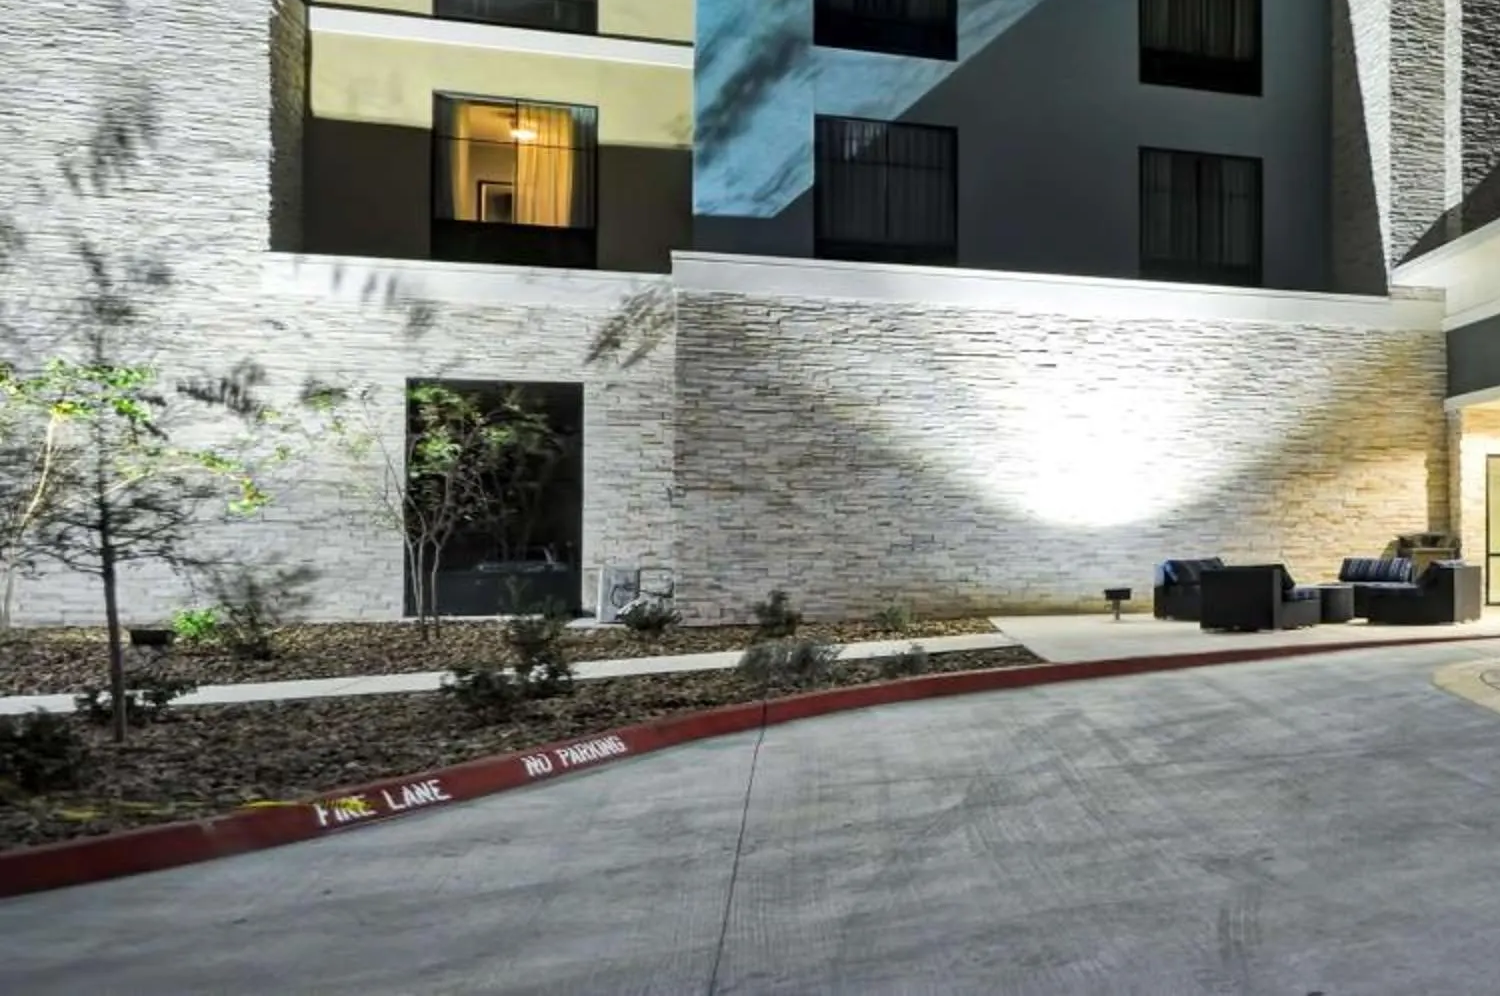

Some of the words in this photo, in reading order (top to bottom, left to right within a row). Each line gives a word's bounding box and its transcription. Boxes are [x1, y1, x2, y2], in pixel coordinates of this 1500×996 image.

[520, 753, 553, 777] NO
[554, 735, 628, 768] PARKING
[381, 779, 453, 811] LANE
